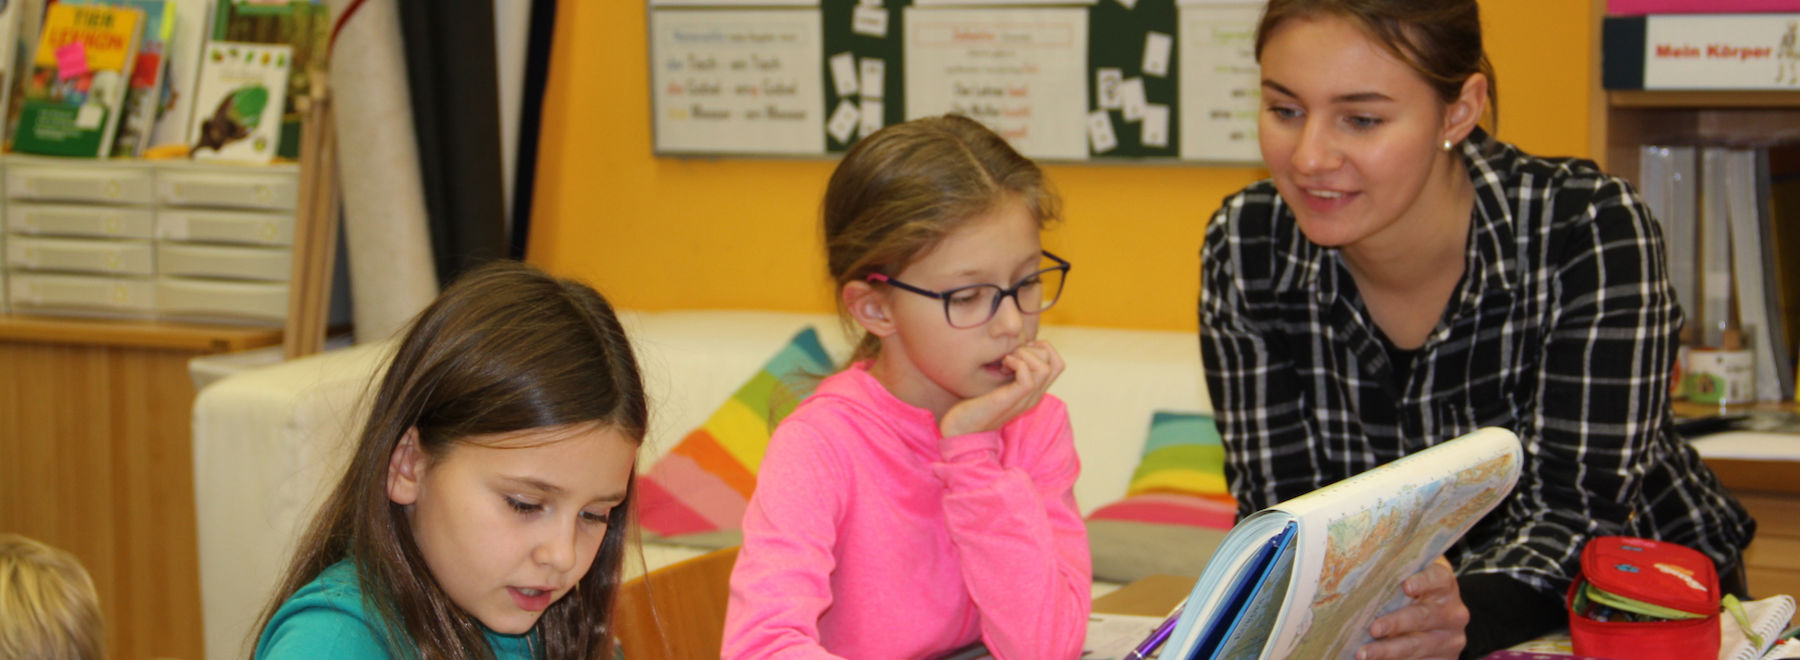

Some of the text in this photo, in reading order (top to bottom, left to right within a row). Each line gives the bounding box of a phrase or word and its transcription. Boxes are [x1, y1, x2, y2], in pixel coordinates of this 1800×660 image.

[73, 9, 116, 28] TIER
[1656, 44, 1773, 61] Mein Körper
